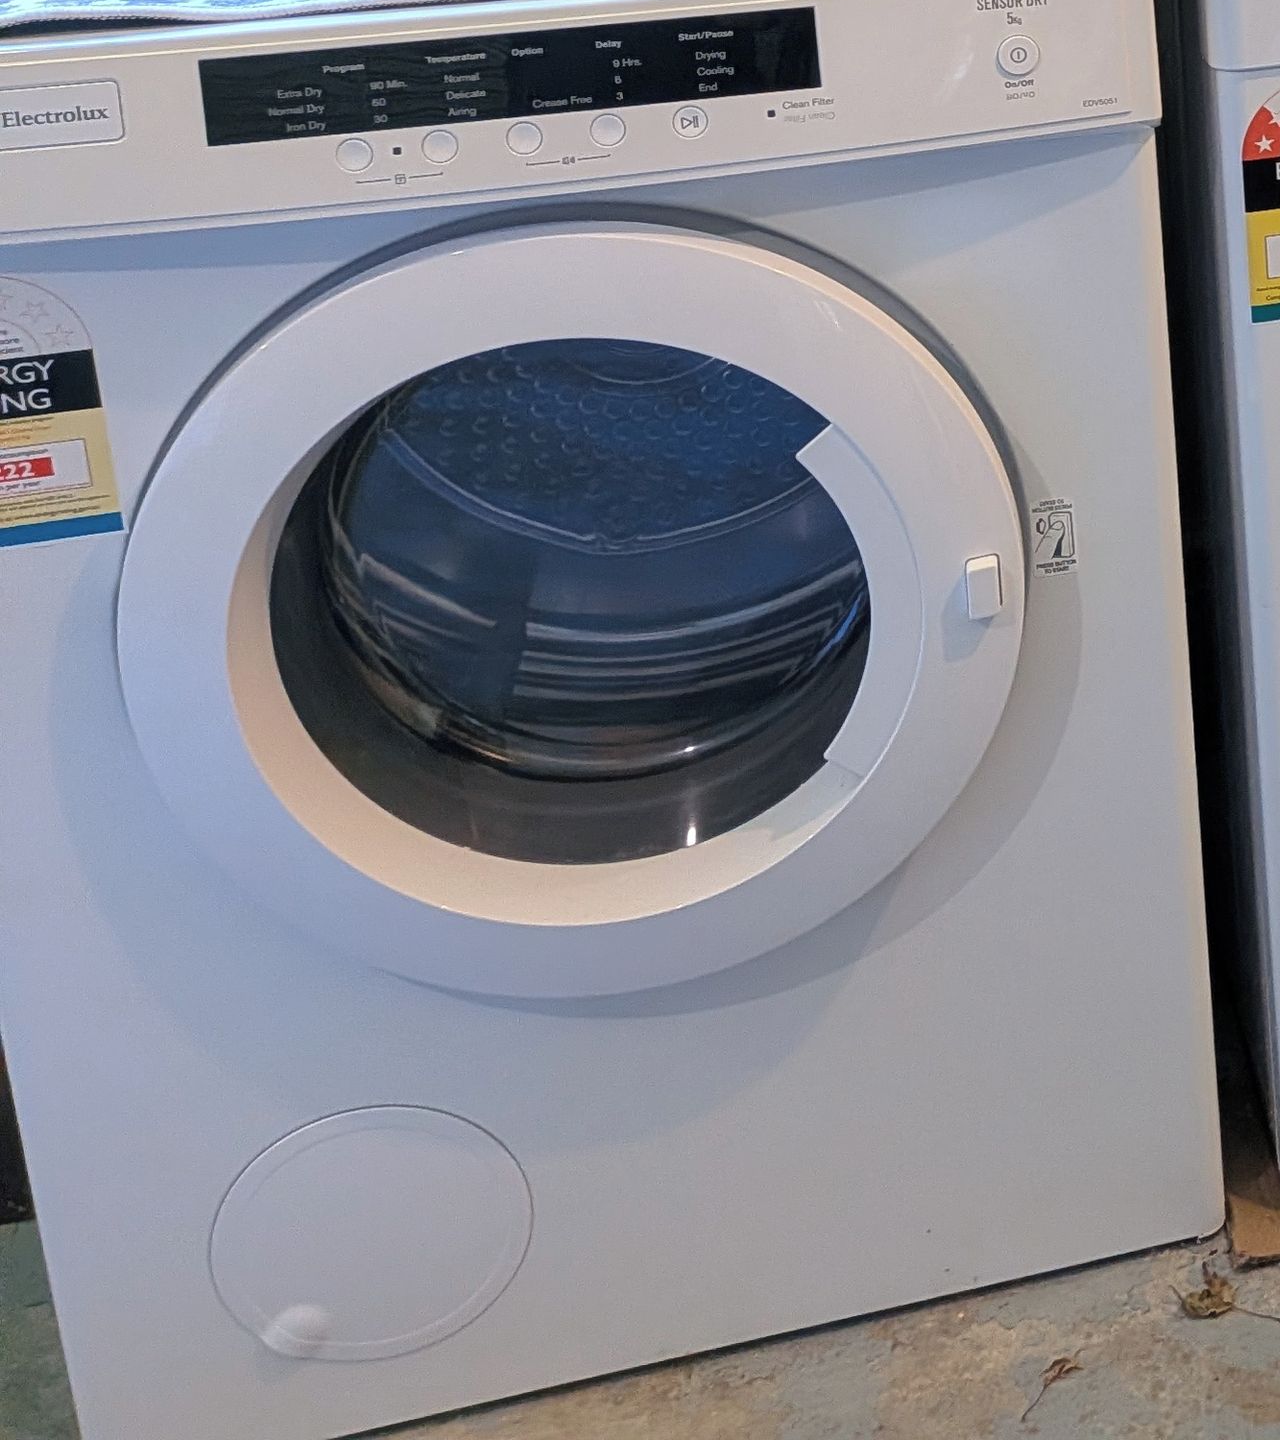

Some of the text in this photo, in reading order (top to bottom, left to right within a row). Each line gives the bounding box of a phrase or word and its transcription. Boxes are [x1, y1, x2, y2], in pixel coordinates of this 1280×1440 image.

[595, 40, 622, 49] Delay
[511, 47, 544, 57] Option
[695, 50, 727, 61] Drying
[424, 52, 487, 64] Temperature
[322, 63, 365, 74] Program
[697, 66, 735, 76] Cooling
[444, 72, 480, 84] Normal
[1004, 79, 1034, 88] On/Off
[370, 81, 384, 90] 90
[699, 82, 718, 92] End
[277, 87, 323, 99] Extra Dry
[445, 89, 486, 101] Delicate
[615, 92, 623, 101] 3
[372, 97, 387, 107] 60
[532, 95, 593, 109] Crease Free
[782, 97, 835, 110] Clean Filter
[268, 104, 325, 117] Normal Dry
[447, 107, 477, 117] Airing
[1, 105, 110, 128] Electrolux
[373, 114, 388, 124] 30
[286, 120, 326, 133] Iron Dry
[0, 359, 55, 385] RGY
